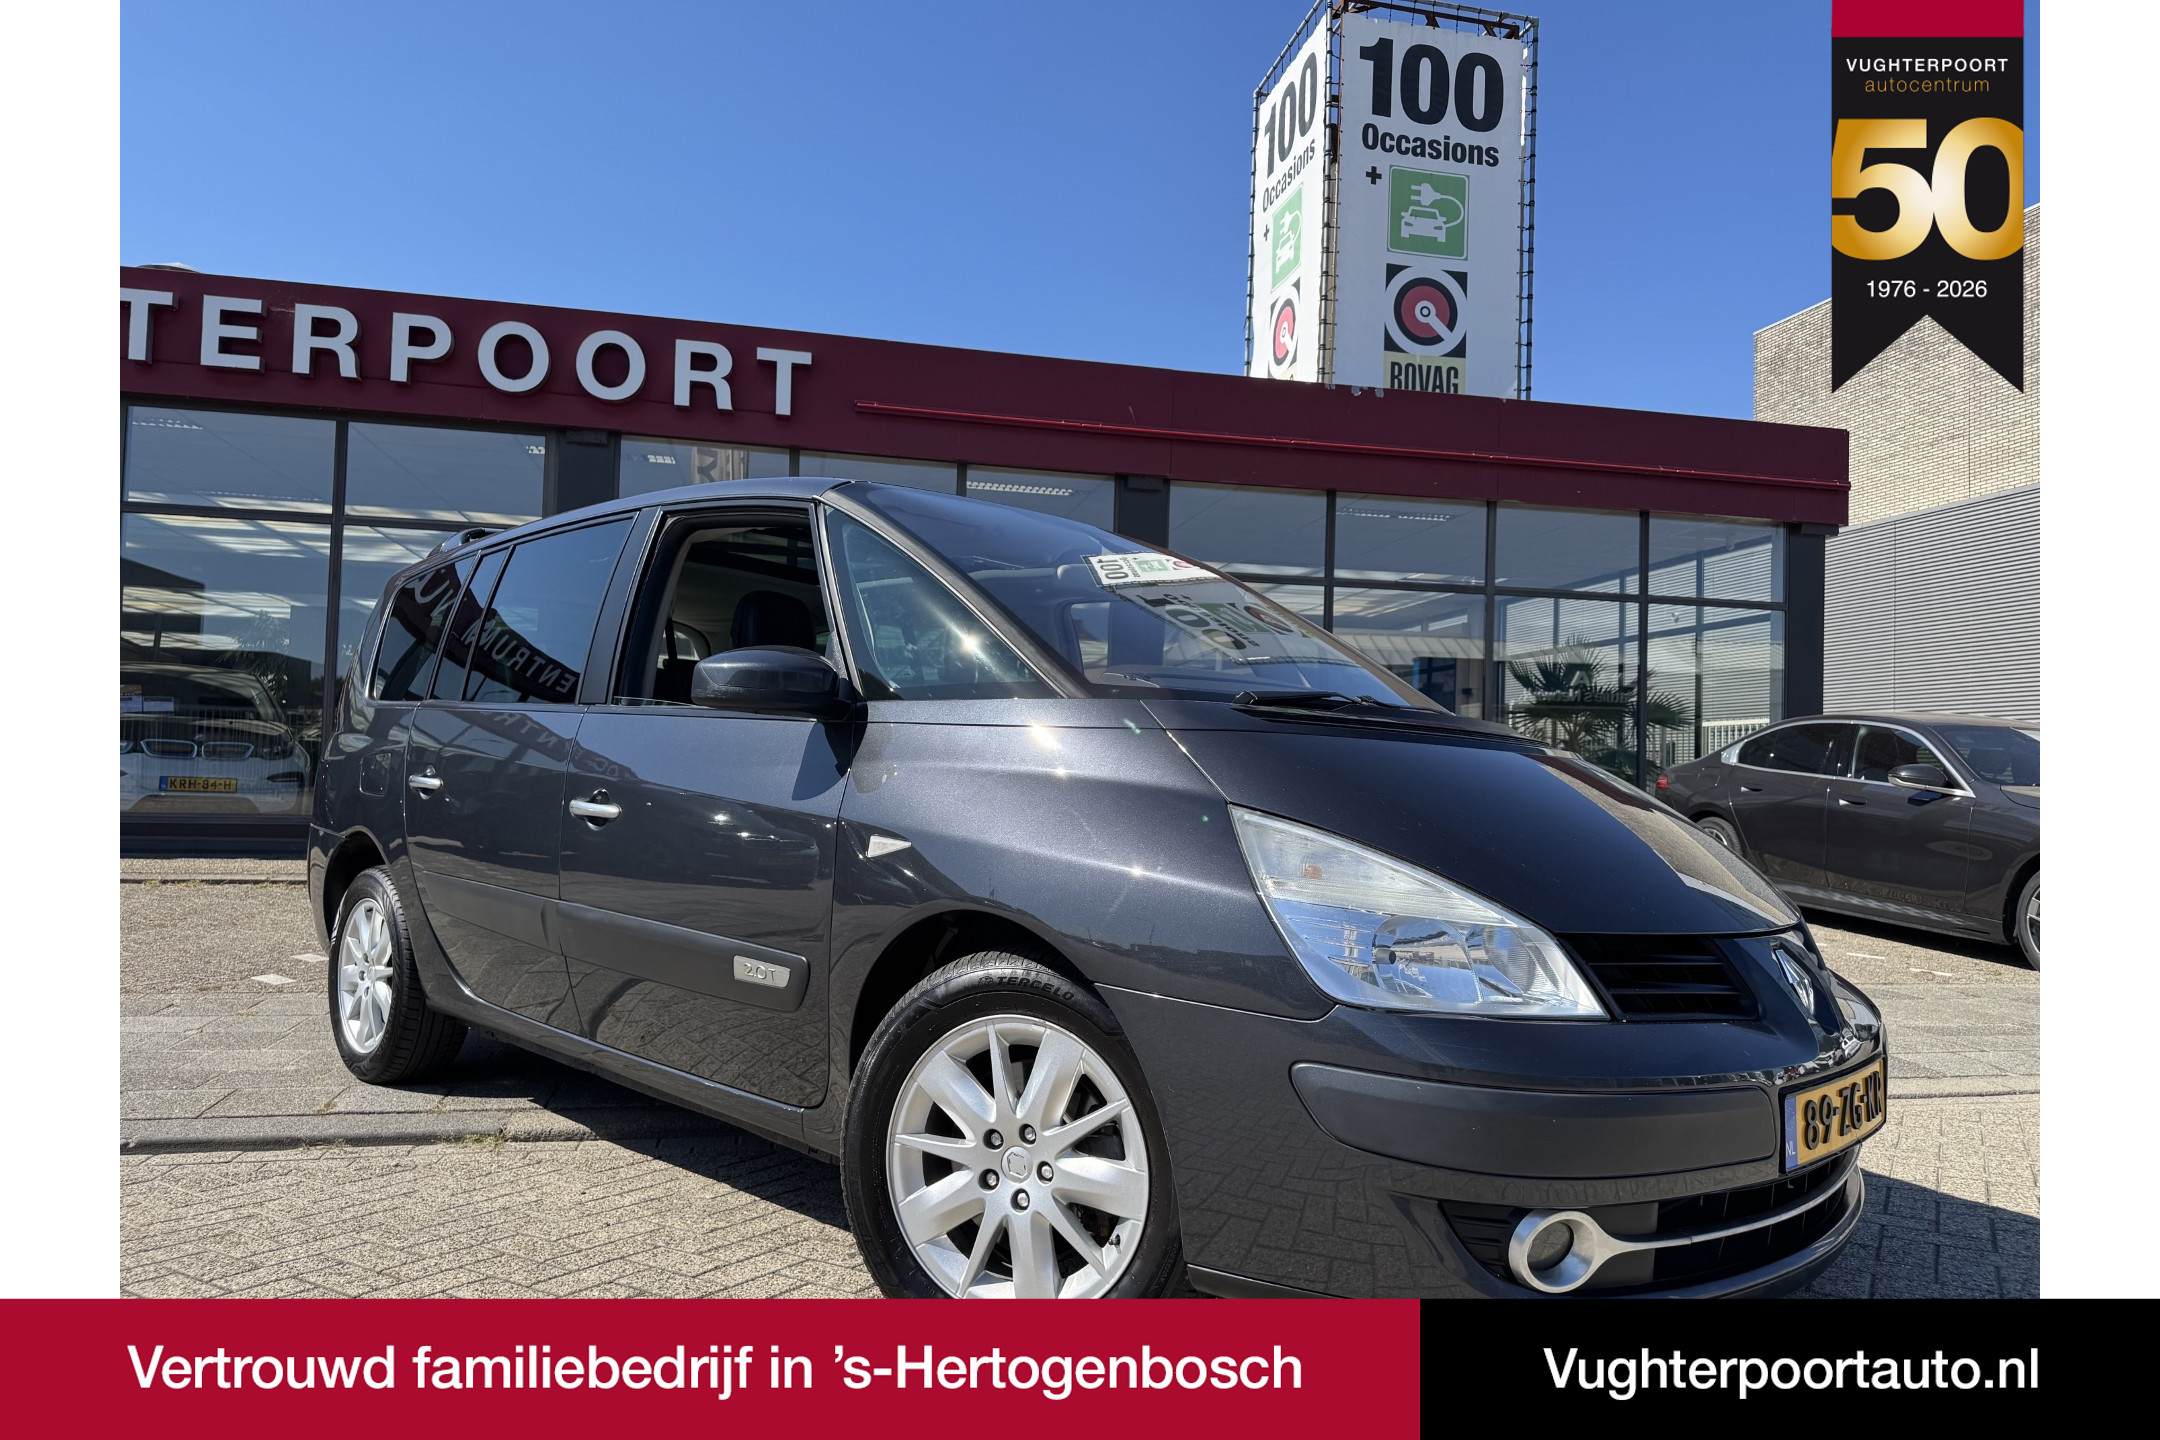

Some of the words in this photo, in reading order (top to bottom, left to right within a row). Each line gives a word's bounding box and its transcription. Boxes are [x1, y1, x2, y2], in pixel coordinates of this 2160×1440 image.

[1263, 52, 1318, 179] 100
[1359, 37, 1504, 133] 100
[1262, 138, 1316, 213] Occasions
[1362, 122, 1500, 167] Occasions
[120, 287, 813, 417] TERPOORT
[743, 961, 776, 982] 2.0T
[997, 975, 1075, 1001] TERCELO
[1803, 1070, 1883, 1151] 89-ZG-KR
[1785, 1142, 1797, 1157] NL
